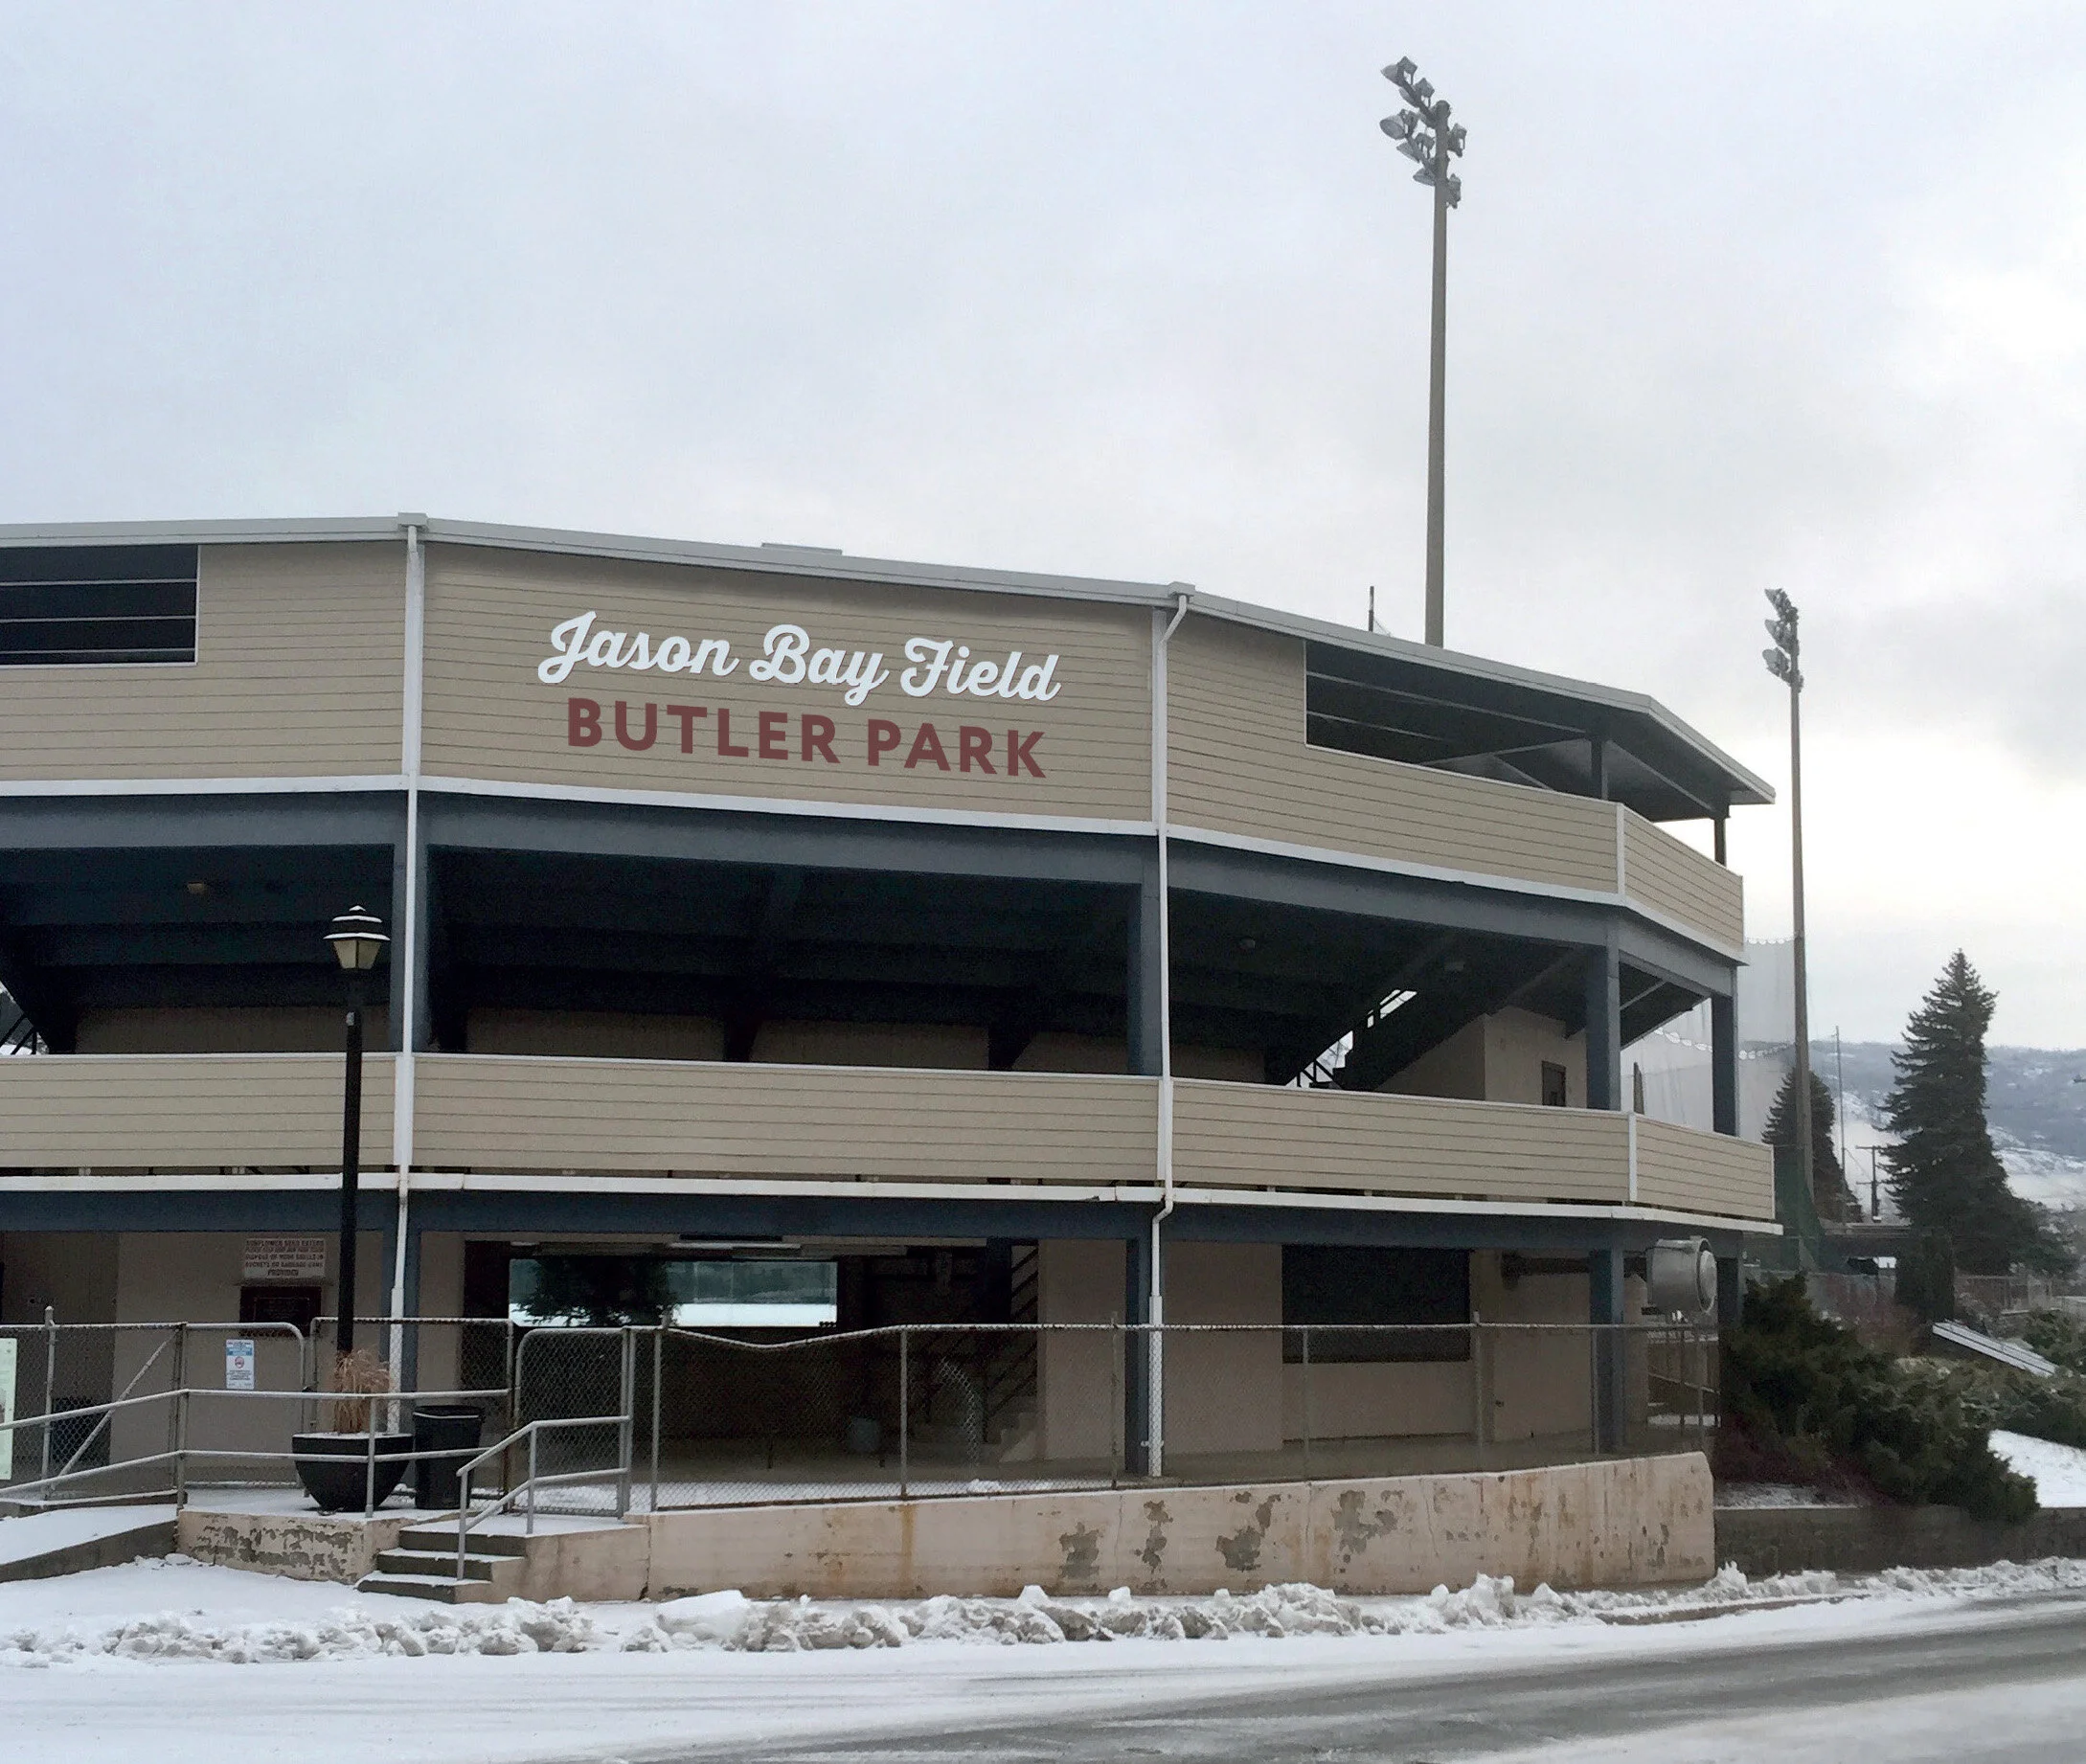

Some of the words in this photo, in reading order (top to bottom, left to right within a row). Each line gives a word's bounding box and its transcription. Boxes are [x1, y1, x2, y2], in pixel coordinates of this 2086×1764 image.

[537, 610, 740, 684] Jason
[749, 623, 890, 706] Bay
[899, 637, 1062, 701] Field
[567, 696, 841, 764] BUTLER
[867, 718, 1047, 779] PARK
